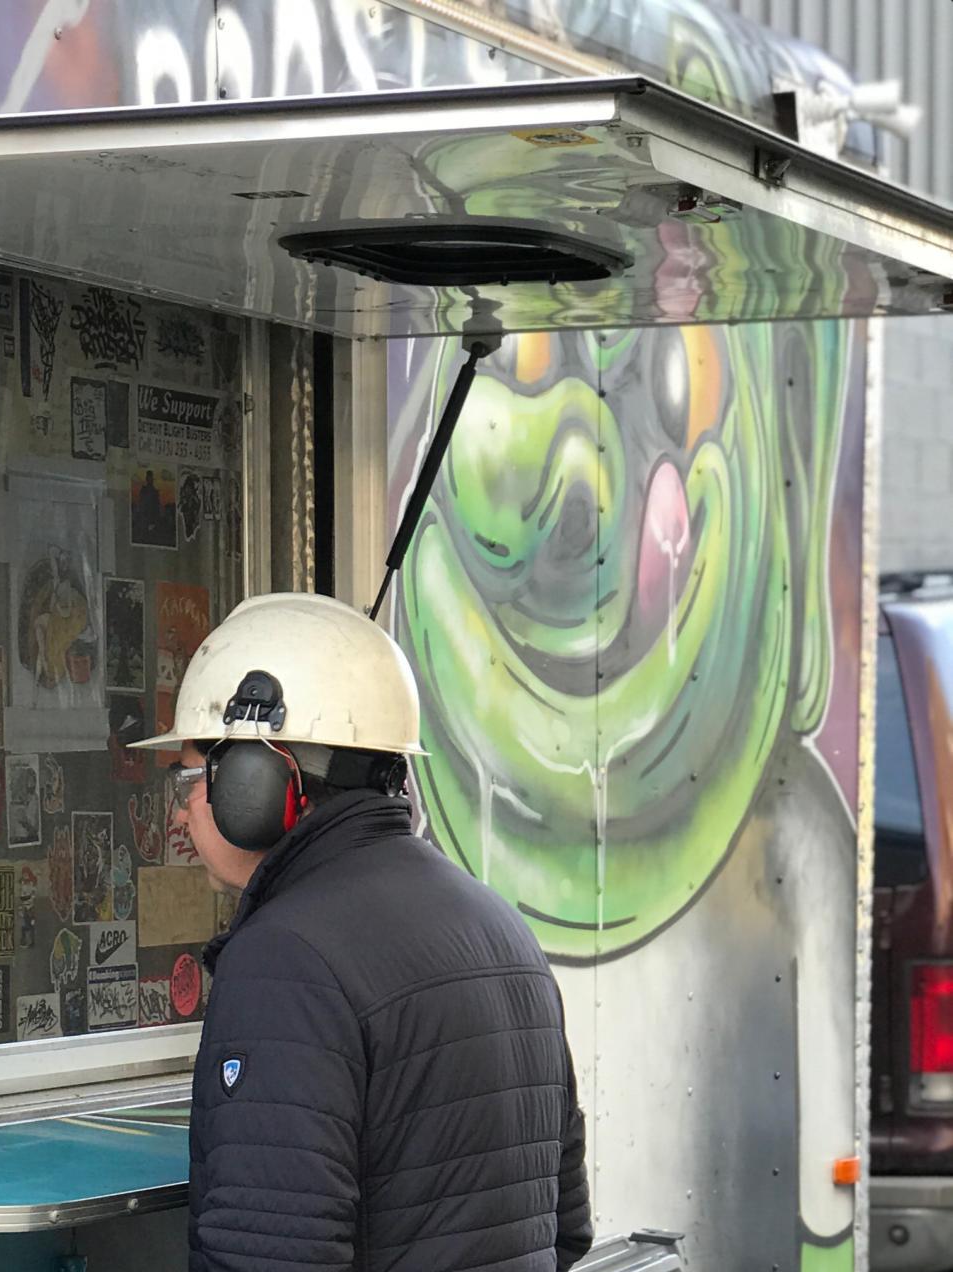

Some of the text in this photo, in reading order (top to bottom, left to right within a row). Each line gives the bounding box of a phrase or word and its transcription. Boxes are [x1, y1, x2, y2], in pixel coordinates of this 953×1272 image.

[139, 386, 213, 423] We Support
[99, 929, 127, 948] ACRO
